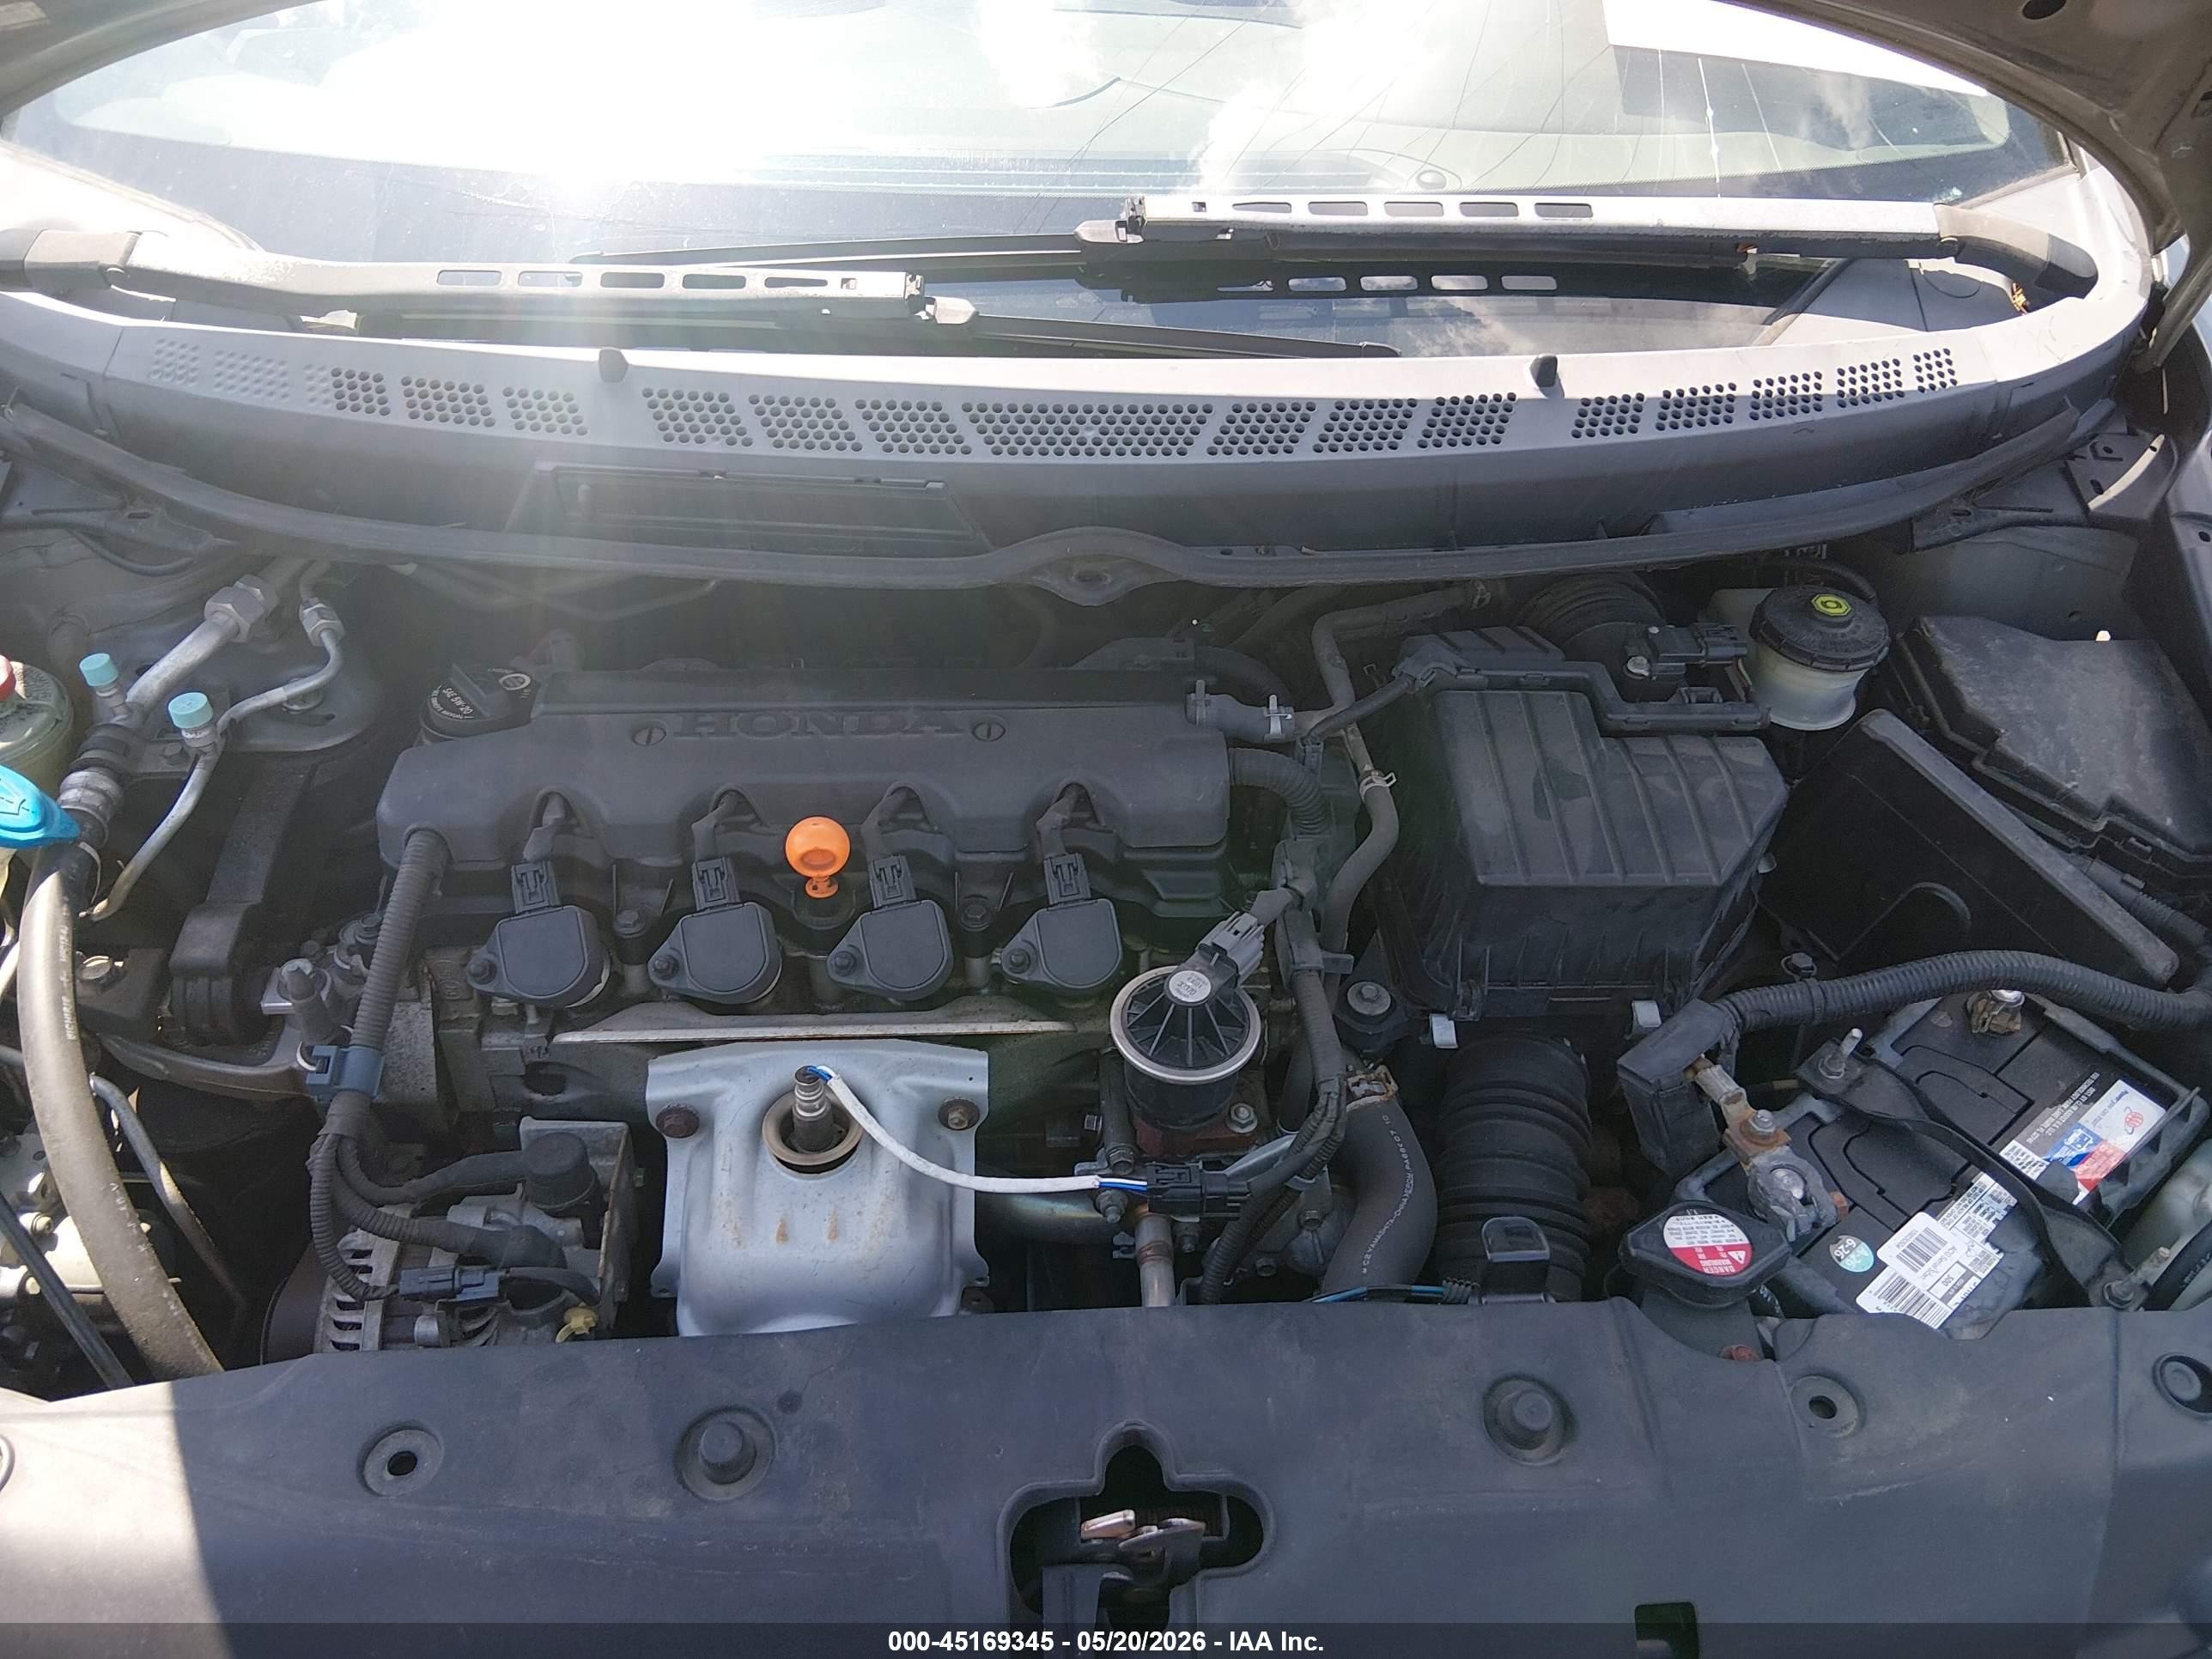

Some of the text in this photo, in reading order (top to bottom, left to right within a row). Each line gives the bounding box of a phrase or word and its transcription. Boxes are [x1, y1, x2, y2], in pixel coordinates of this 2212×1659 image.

[442, 688, 474, 714] SAE 5W-20
[674, 711, 965, 739] HONDA
[1833, 1238, 1856, 1260] 6-26
[1703, 1265, 1736, 1274] DANGER
[1942, 1274, 1954, 1286] 500
